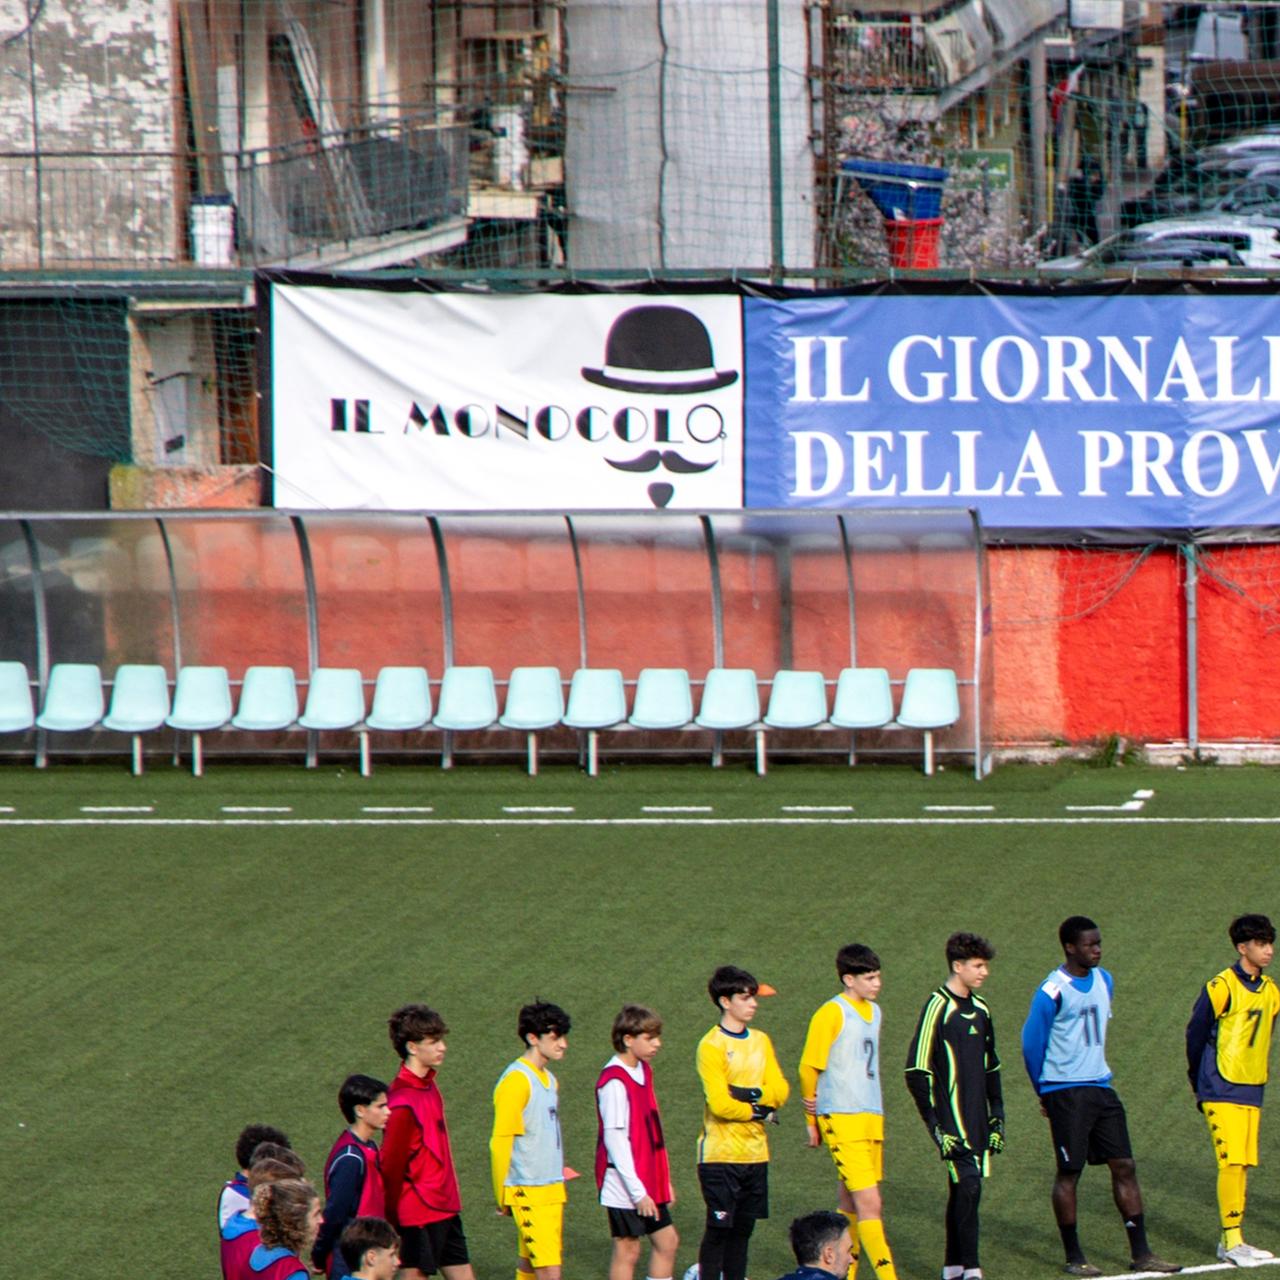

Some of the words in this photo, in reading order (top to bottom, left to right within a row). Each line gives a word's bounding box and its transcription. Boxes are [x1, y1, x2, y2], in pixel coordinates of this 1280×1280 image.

[789, 336, 870, 403] IL
[330, 398, 384, 433] IL
[403, 403, 727, 444] MONOCOLO
[791, 429, 1061, 497] DELLA
[1080, 1004, 1103, 1047] 11
[1248, 1009, 1263, 1048] 7
[864, 1039, 874, 1079] 2
